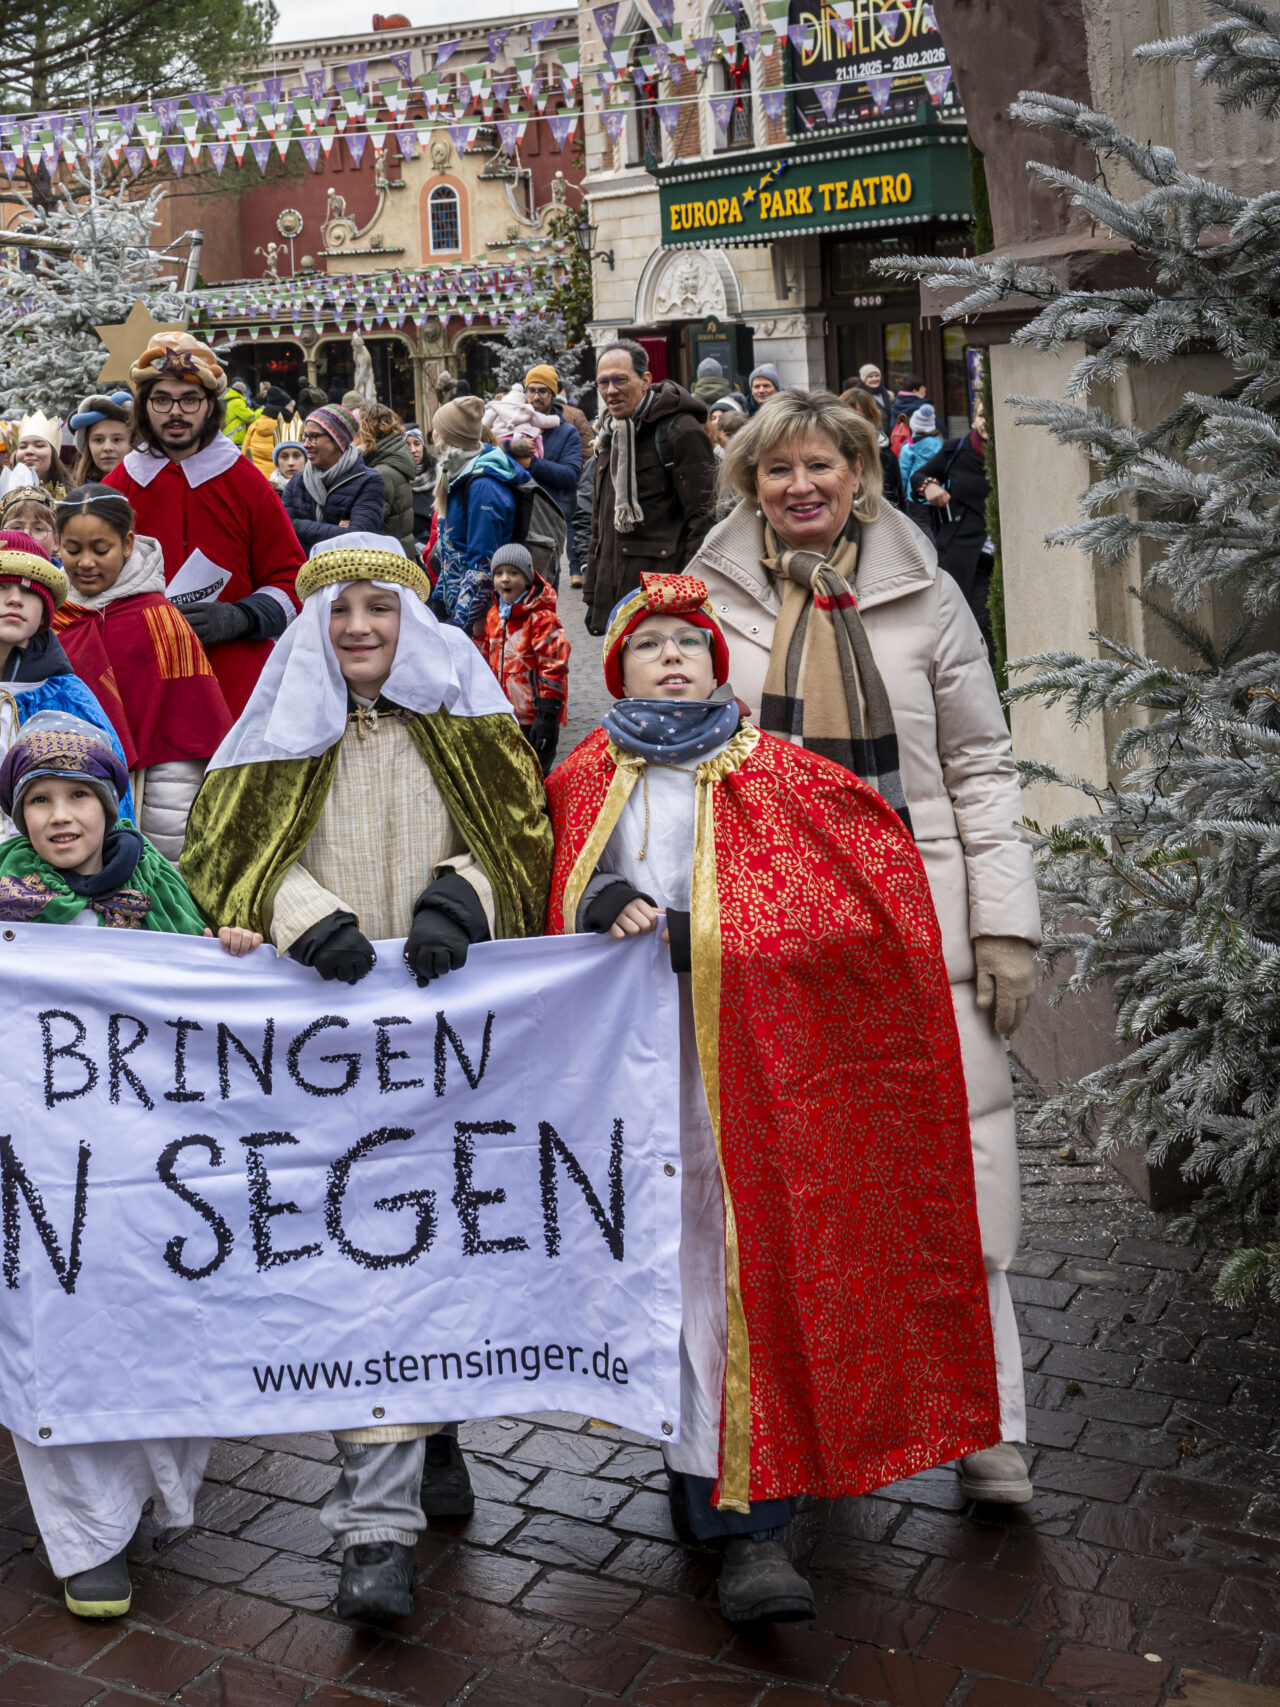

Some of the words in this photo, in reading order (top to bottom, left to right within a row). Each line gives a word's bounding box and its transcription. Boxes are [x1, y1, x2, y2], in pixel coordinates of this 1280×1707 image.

[835, 60, 882, 81] 21.11.2025
[892, 47, 946, 72] 28.02.2026
[670, 196, 743, 231] EUROPA
[759, 186, 813, 220] PARK
[818, 172, 913, 212] TEATRO
[38, 1010, 496, 1110] BRINGEN
[156, 1118, 625, 1281] SEGEN
[252, 1339, 629, 1393] www.sternsinger.de
